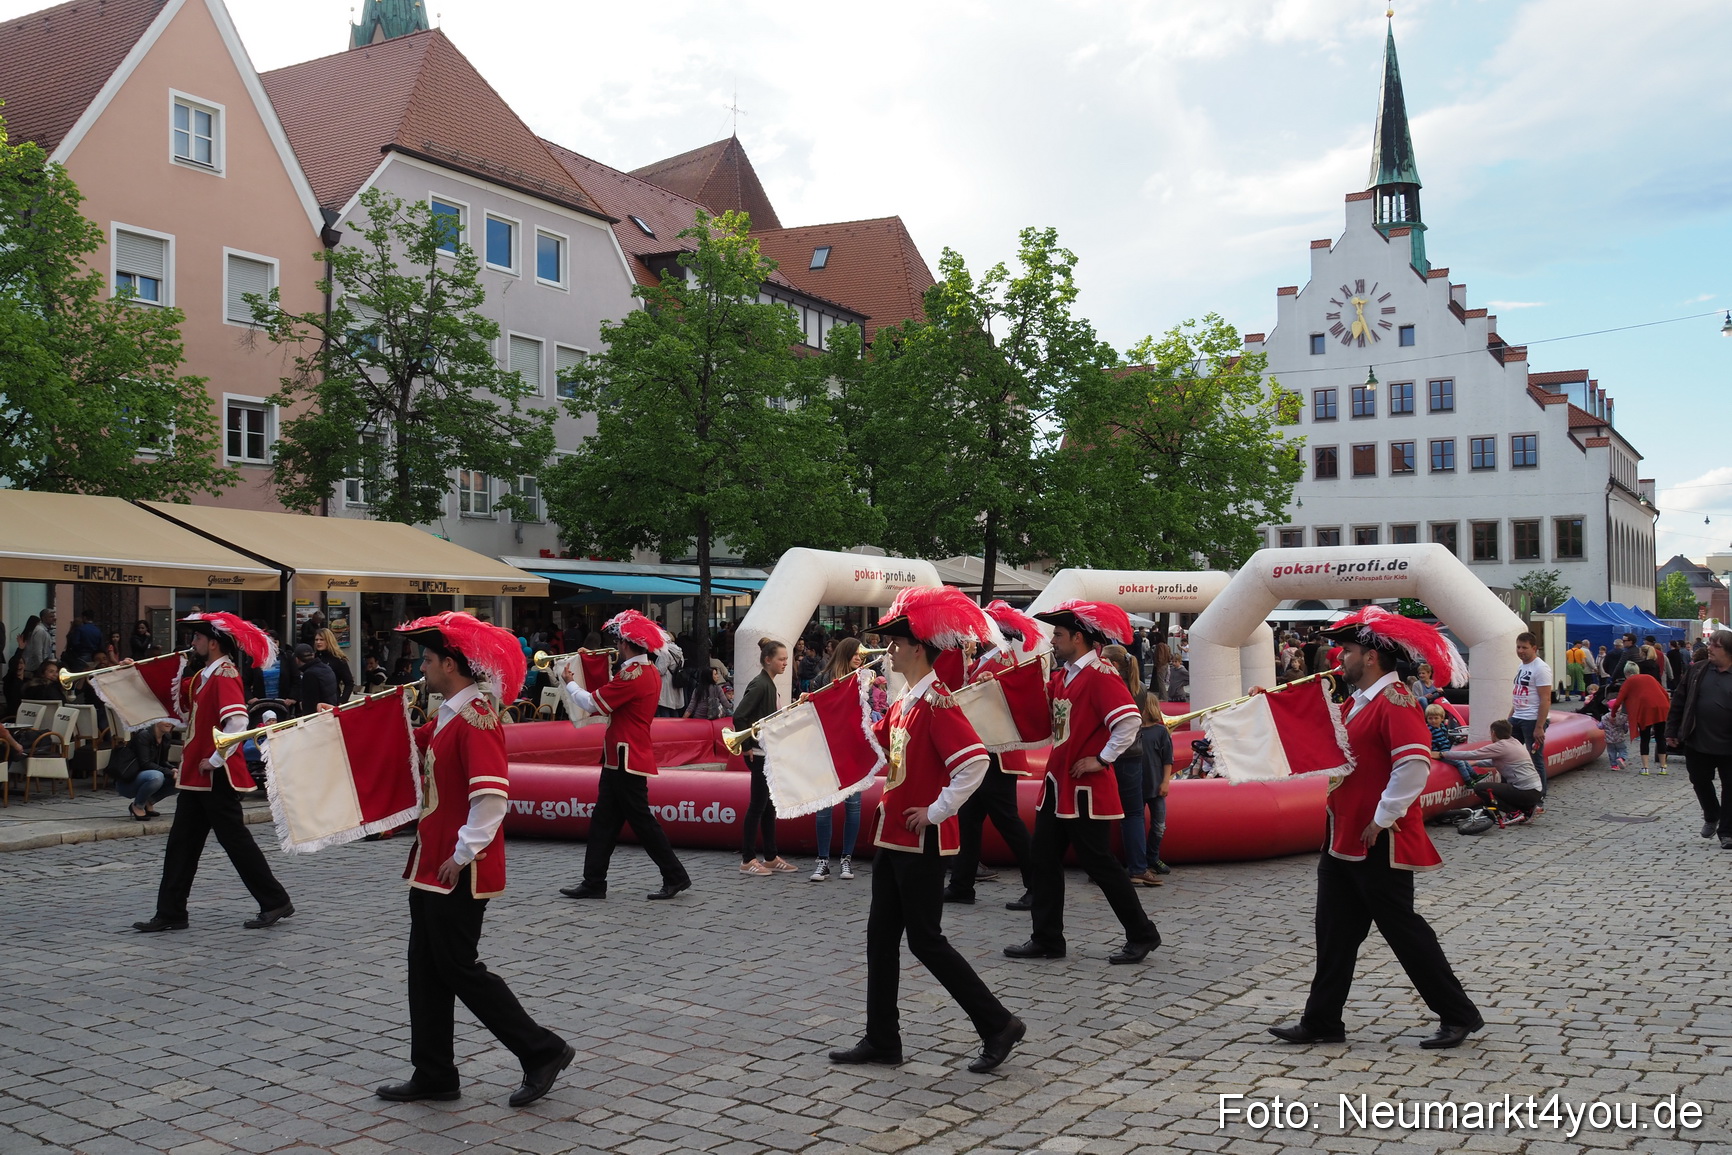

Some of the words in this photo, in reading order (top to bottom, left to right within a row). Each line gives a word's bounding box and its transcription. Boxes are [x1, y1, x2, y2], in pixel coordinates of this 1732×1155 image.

[64, 564, 78, 573] EIS
[1272, 559, 1408, 578] gokart-profi.de
[854, 568, 916, 583] gokart-profi.de
[1354, 574, 1383, 582] Fahrspaß
[1118, 583, 1199, 595] gokart-profi.de
